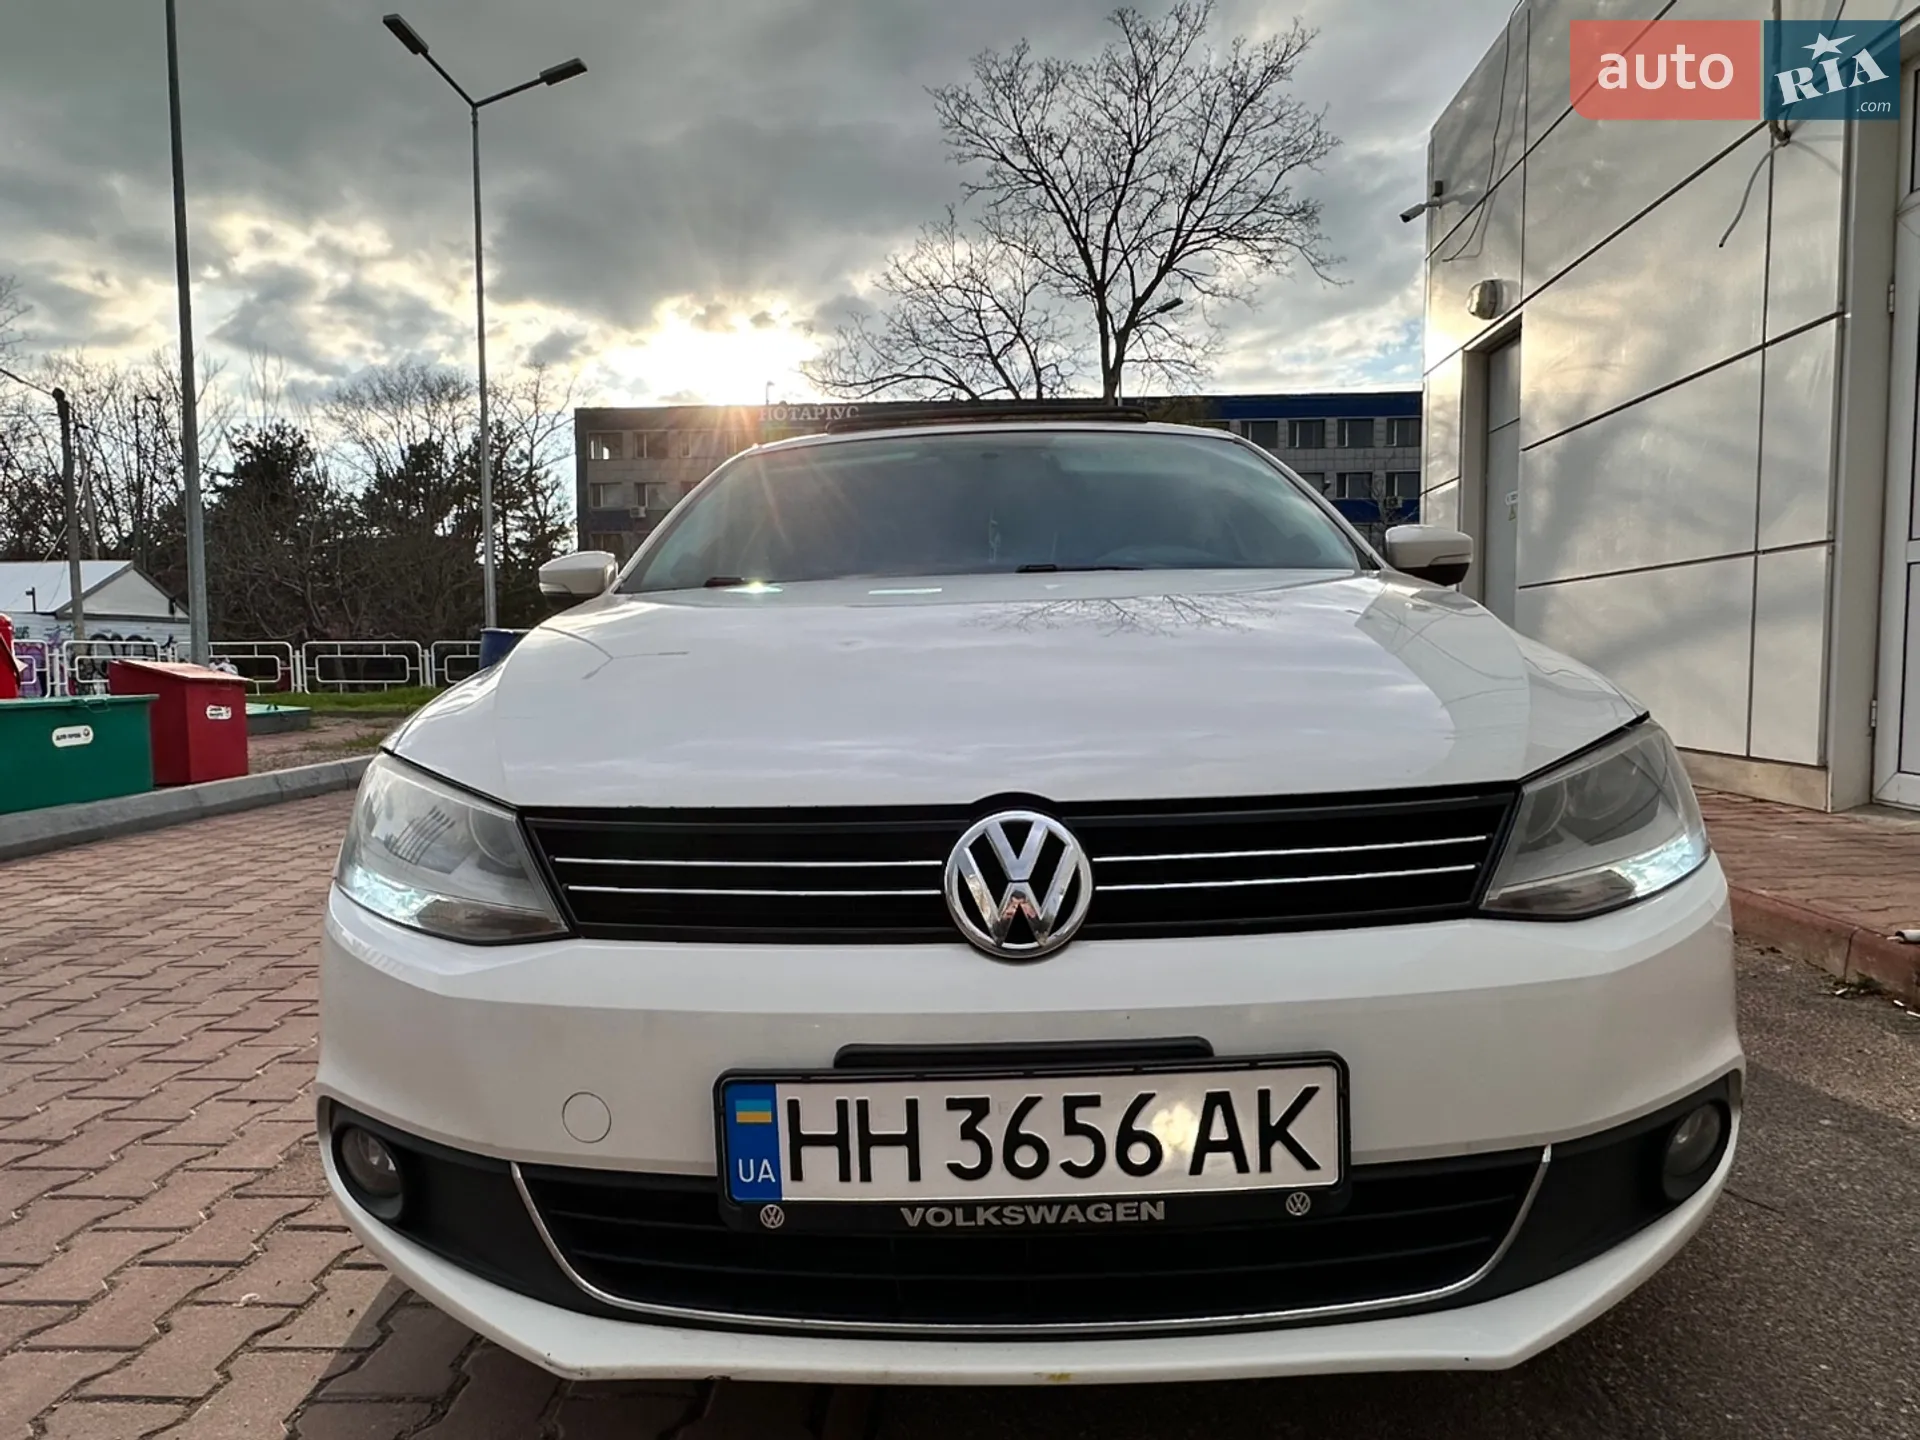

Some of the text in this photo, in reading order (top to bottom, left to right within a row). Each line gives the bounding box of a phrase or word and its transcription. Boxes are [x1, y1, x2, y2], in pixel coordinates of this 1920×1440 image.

[787, 1086, 1322, 1183] HH 3656 AK
[738, 1158, 776, 1183] UA
[900, 1201, 1166, 1227] VOLKSWAGEN
